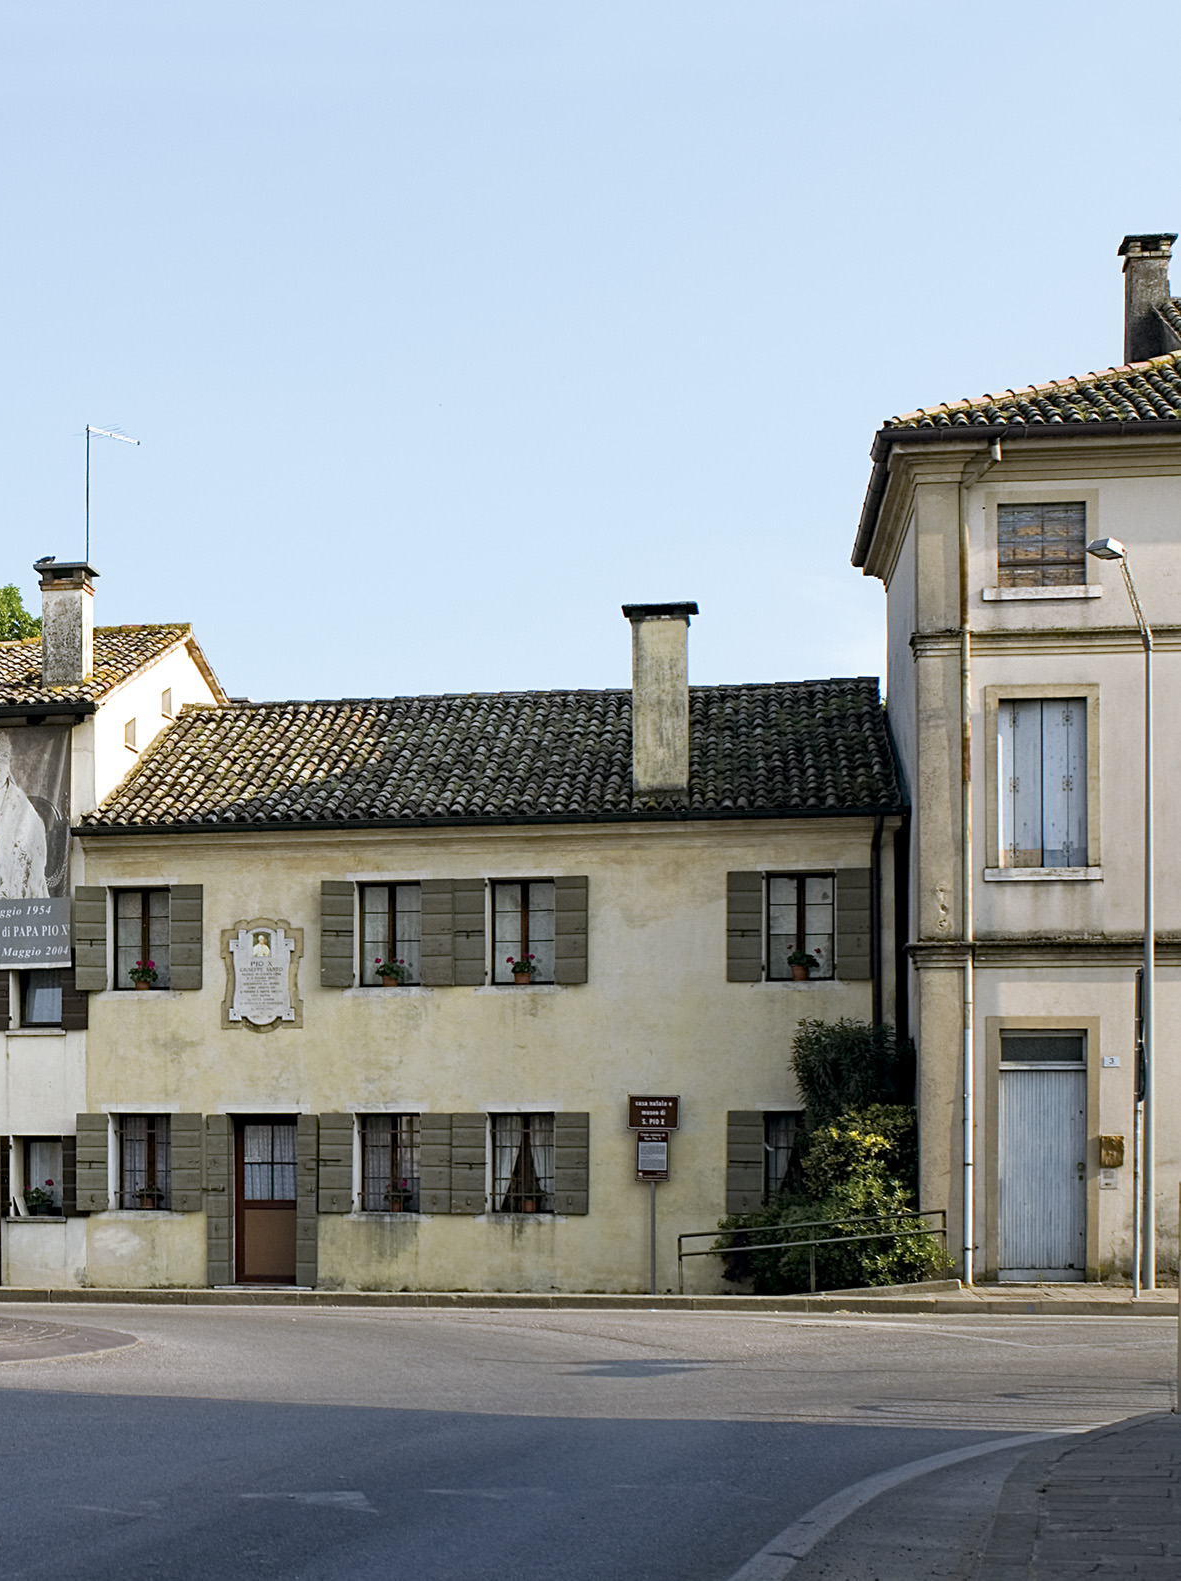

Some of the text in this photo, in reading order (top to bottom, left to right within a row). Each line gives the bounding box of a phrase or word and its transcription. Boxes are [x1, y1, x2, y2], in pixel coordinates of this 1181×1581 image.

[26, 905, 52, 915] 1954
[2, 926, 10, 937] di
[13, 925, 38, 936] PAPA
[42, 924, 59, 936] PIO
[2, 946, 42, 958] Maggio
[45, 946, 68, 956] 2004
